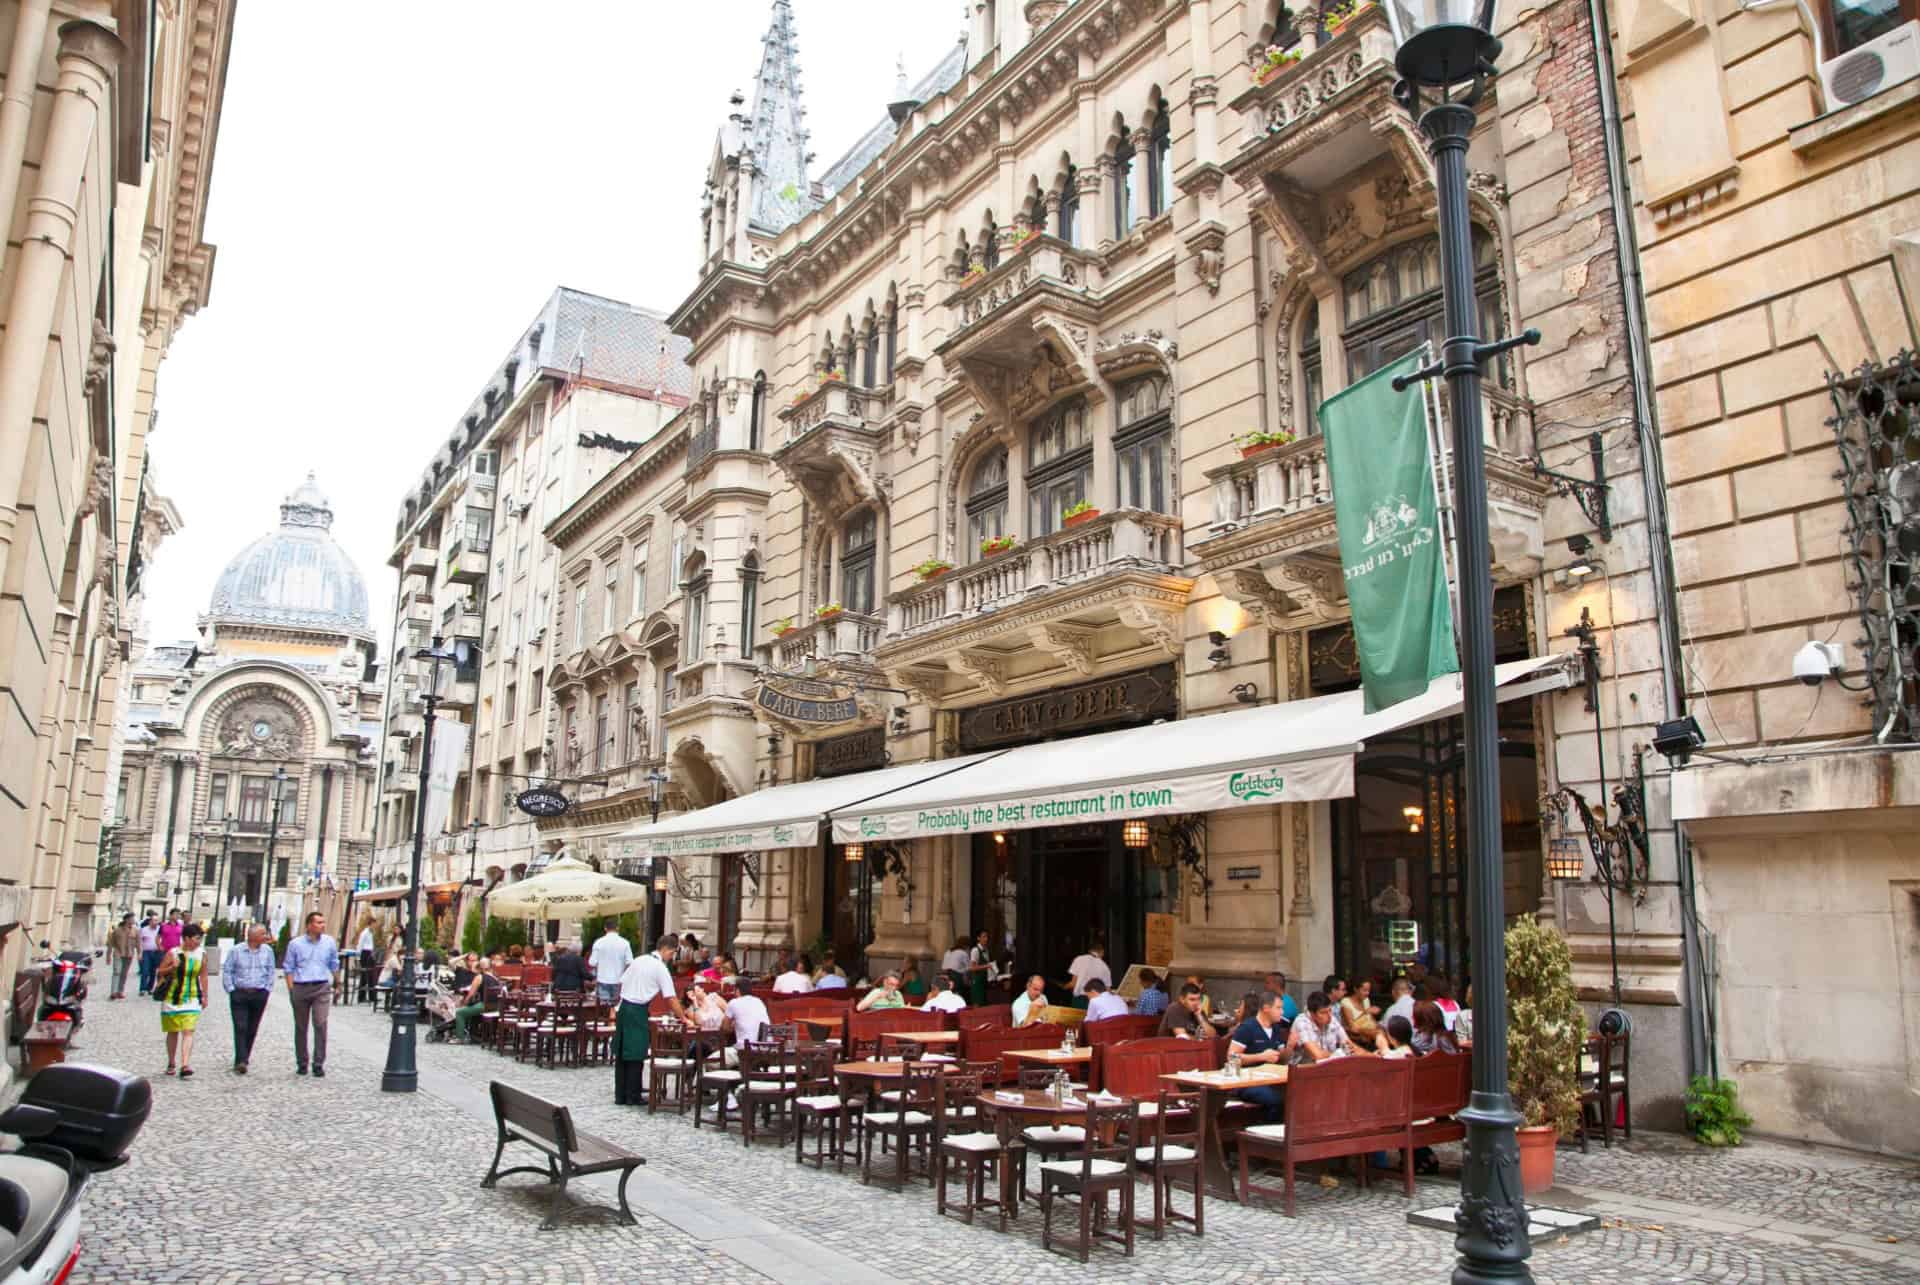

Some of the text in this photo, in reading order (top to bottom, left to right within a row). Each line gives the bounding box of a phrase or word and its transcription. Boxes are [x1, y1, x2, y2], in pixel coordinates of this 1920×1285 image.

[1071, 682, 1129, 719] BERE
[1229, 769, 1284, 799] Carlsberg
[918, 788, 1172, 831] Probably the best restaurant in town
